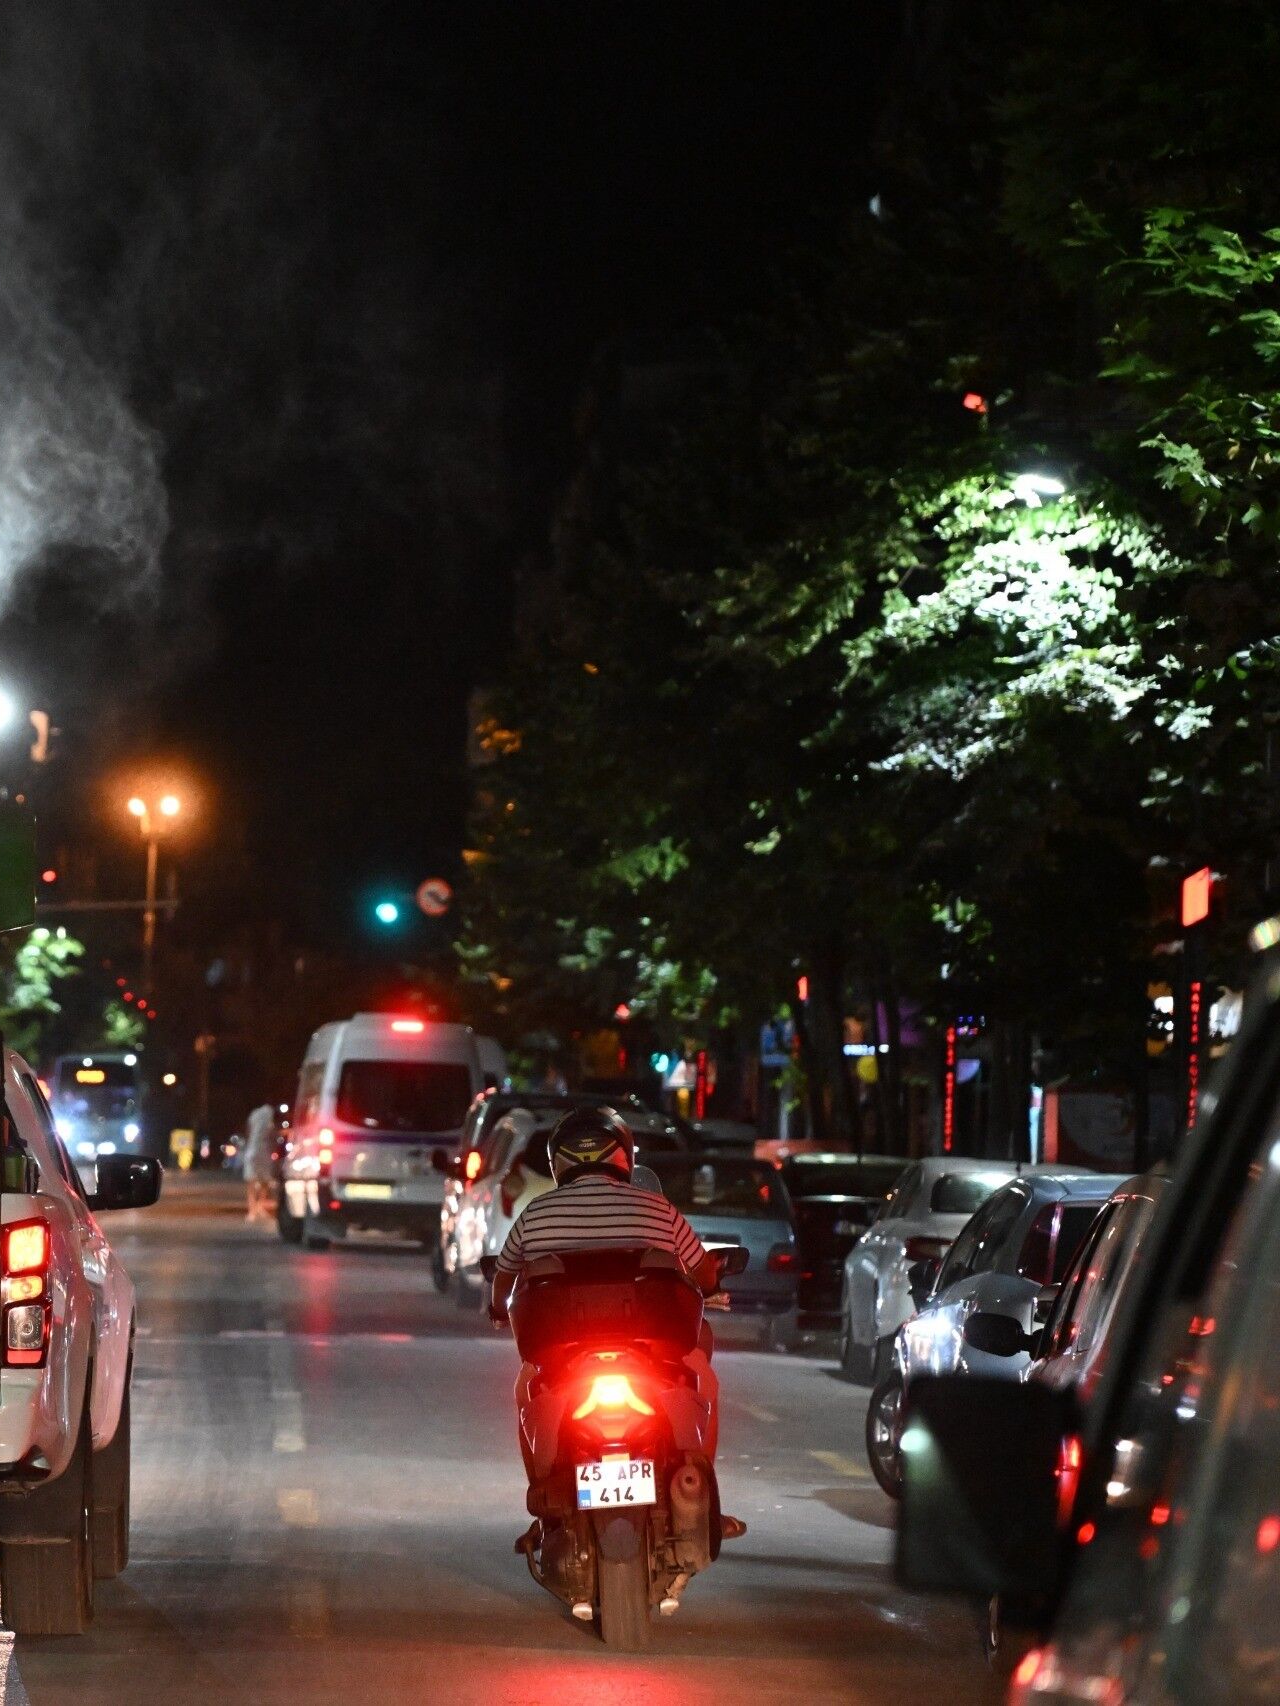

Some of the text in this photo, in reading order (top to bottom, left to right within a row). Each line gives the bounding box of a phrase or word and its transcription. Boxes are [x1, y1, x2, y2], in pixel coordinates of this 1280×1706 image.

[579, 1462, 651, 1482] 45 APR
[599, 1486, 635, 1503] 414
